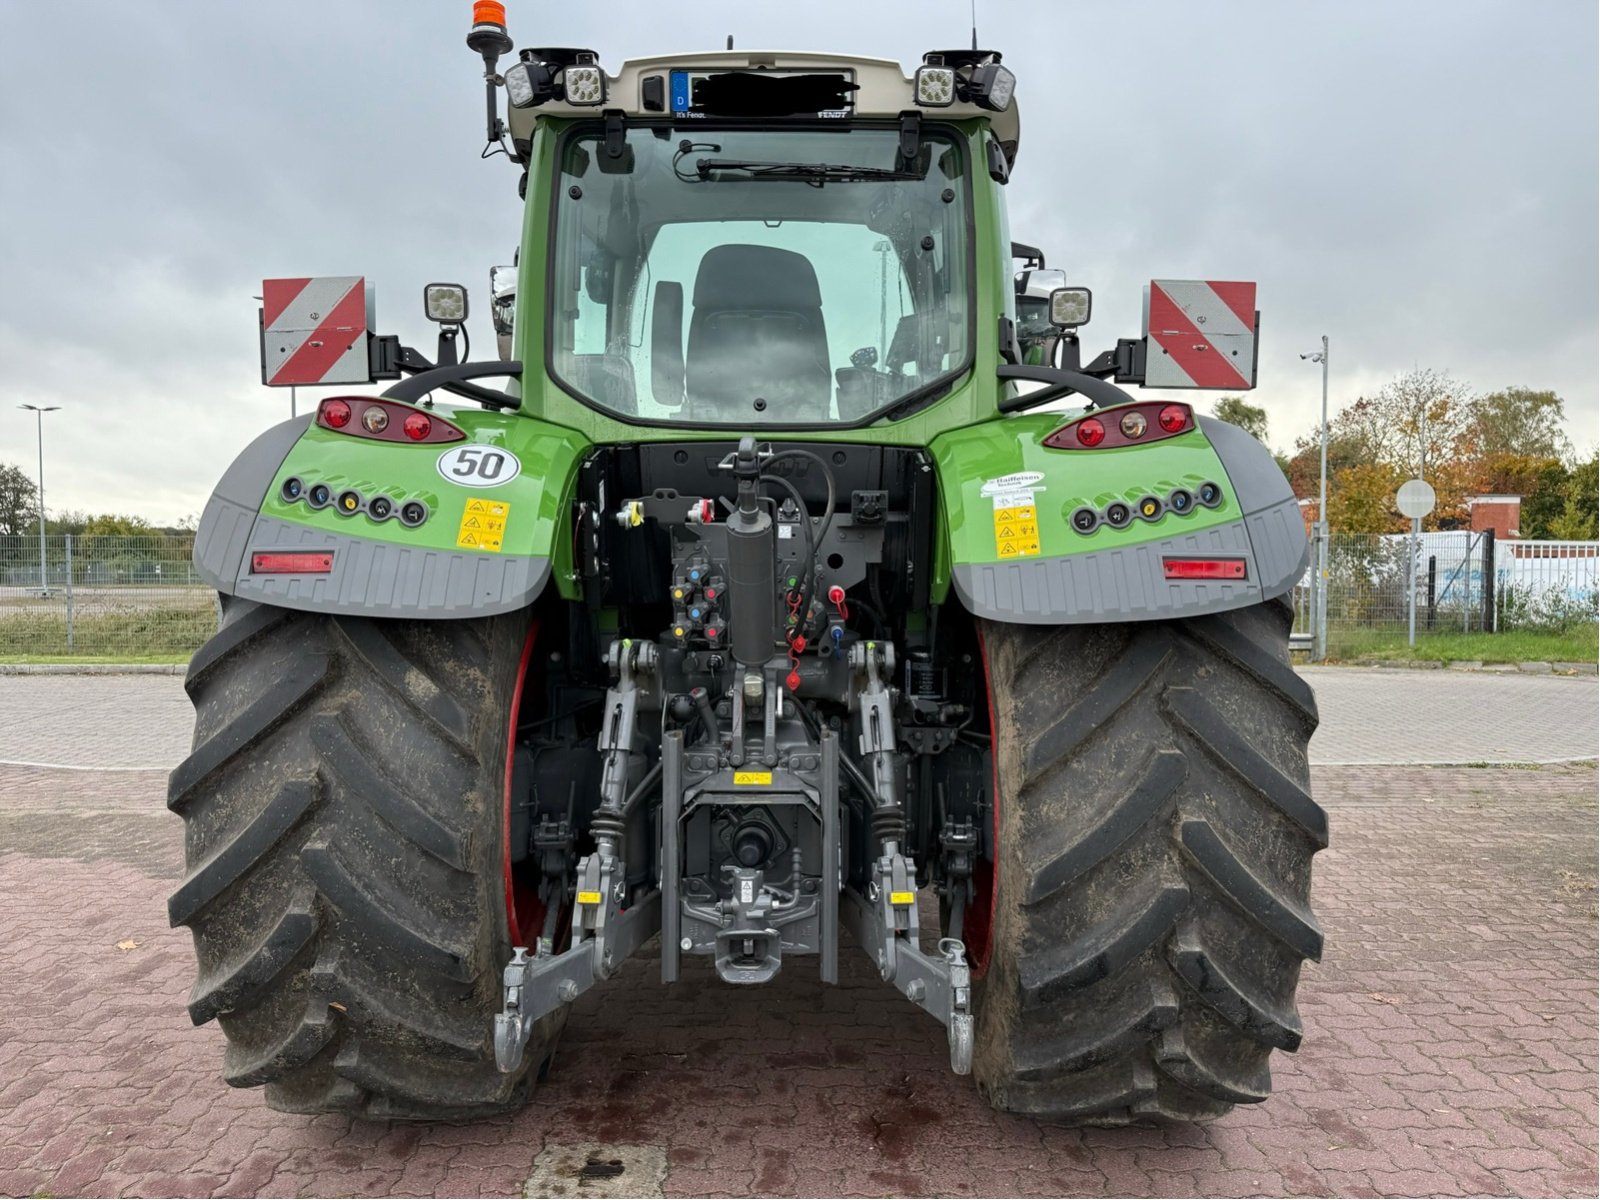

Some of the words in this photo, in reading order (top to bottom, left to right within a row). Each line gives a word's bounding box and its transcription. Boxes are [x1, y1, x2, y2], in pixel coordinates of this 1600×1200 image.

[677, 96, 684, 105] D
[817, 111, 848, 119] FENDT
[452, 449, 505, 480] 50
